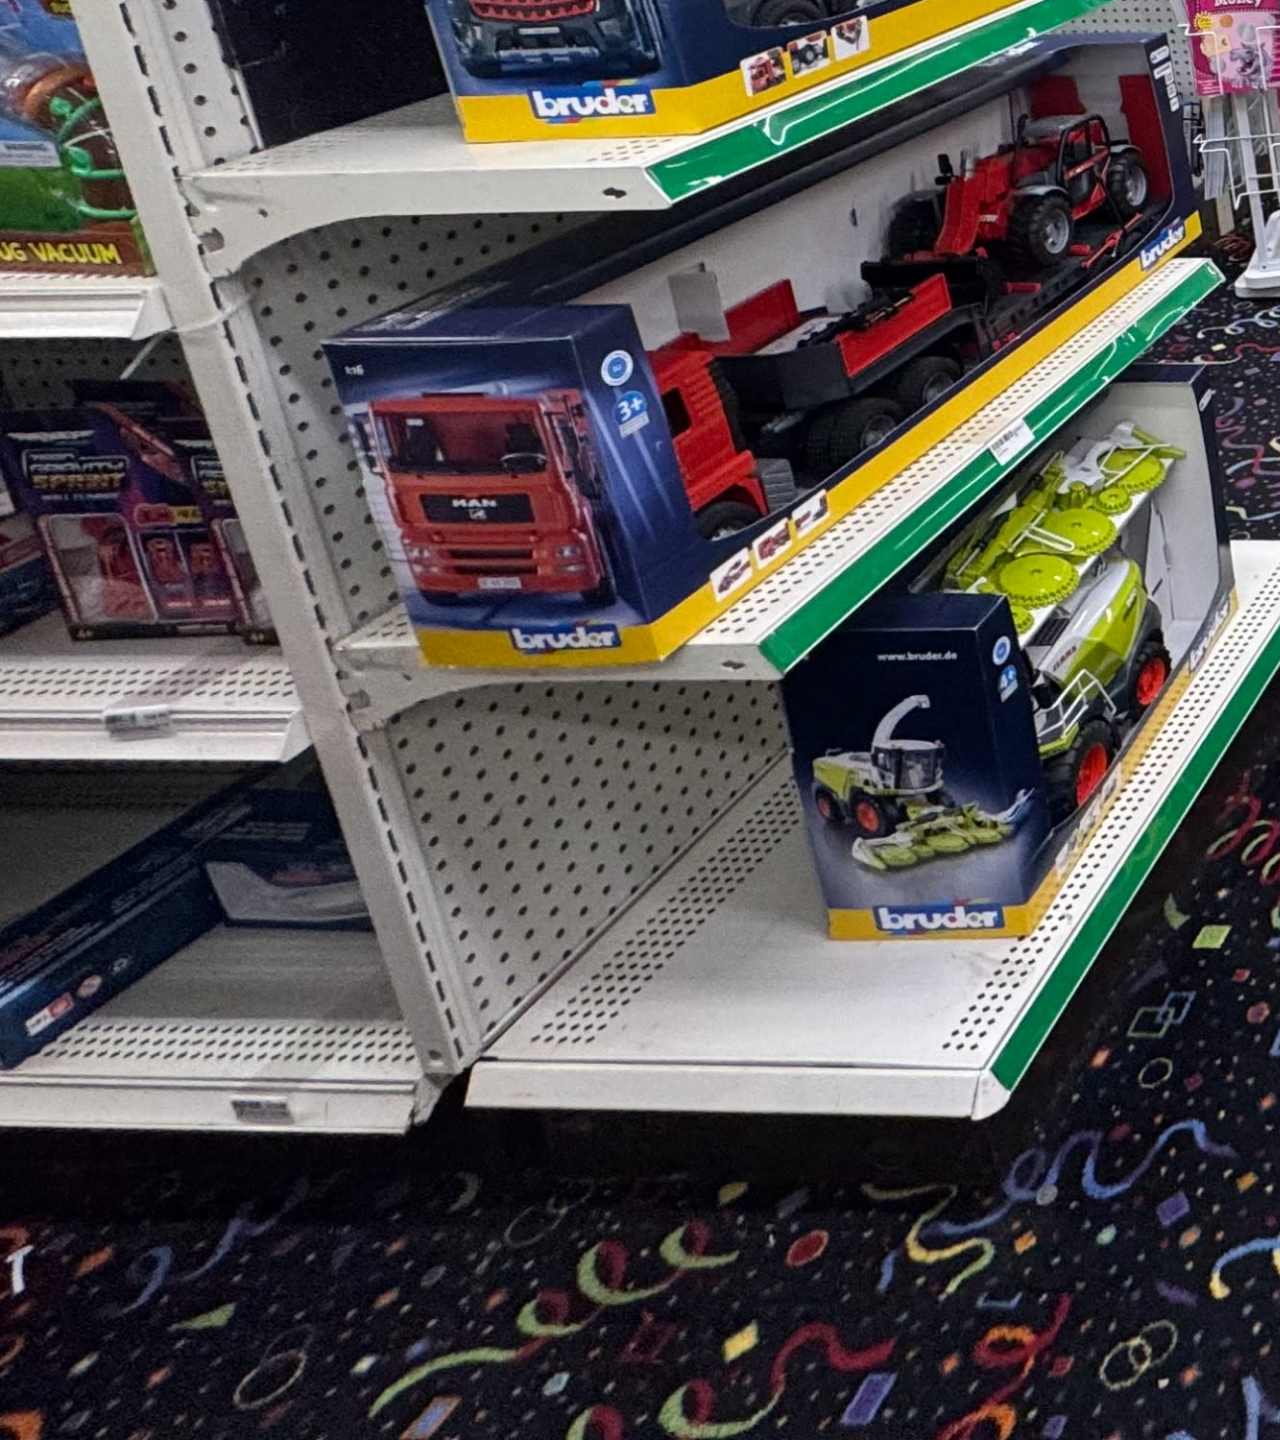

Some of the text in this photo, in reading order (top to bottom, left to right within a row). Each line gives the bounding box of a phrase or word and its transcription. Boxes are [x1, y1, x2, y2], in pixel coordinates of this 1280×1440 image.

[533, 89, 650, 118] bruder
[28, 241, 123, 265] VACUUM
[617, 393, 646, 421] 3+
[451, 498, 497, 510] MAN
[513, 625, 618, 651] bruder
[877, 650, 958, 663] www.bruder.de
[878, 905, 1000, 931] bruder
